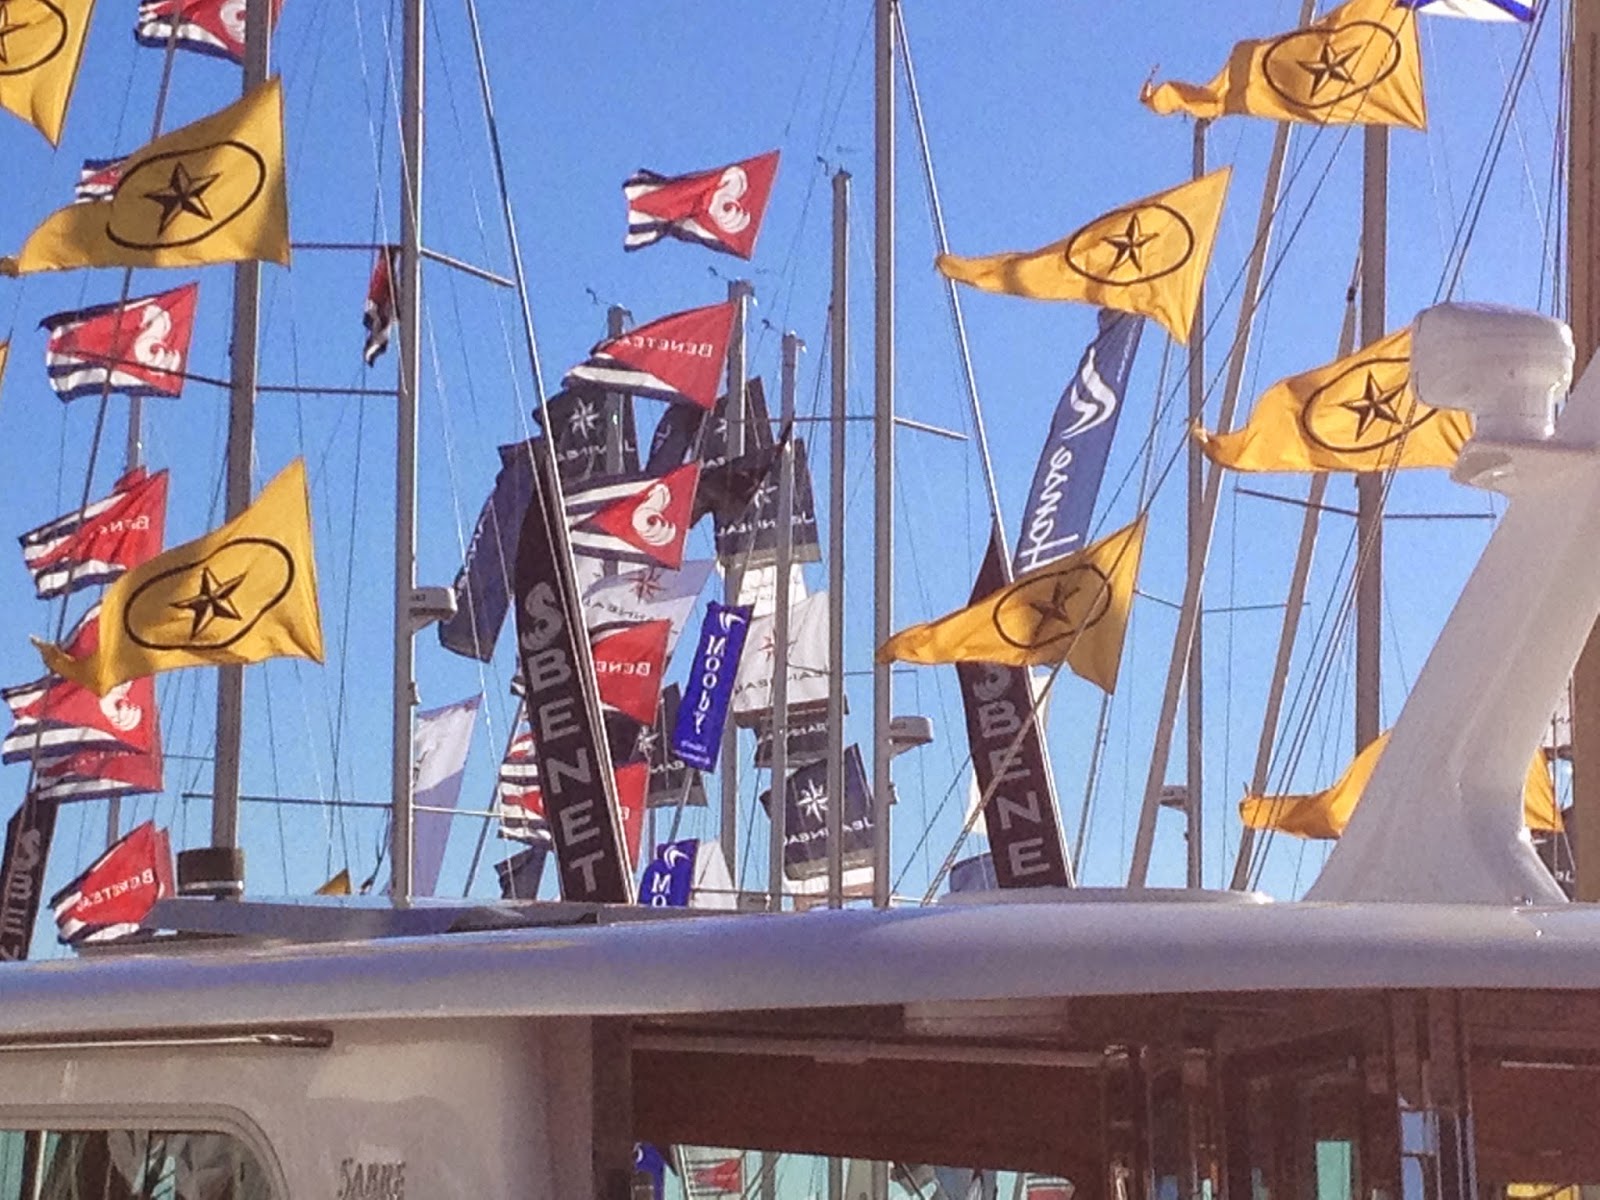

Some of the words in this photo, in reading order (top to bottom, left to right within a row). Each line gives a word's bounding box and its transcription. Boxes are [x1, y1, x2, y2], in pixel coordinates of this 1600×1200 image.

[527, 648, 604, 894] BENET
[693, 634, 726, 735] MOODY
[978, 701, 1051, 877] BENE
